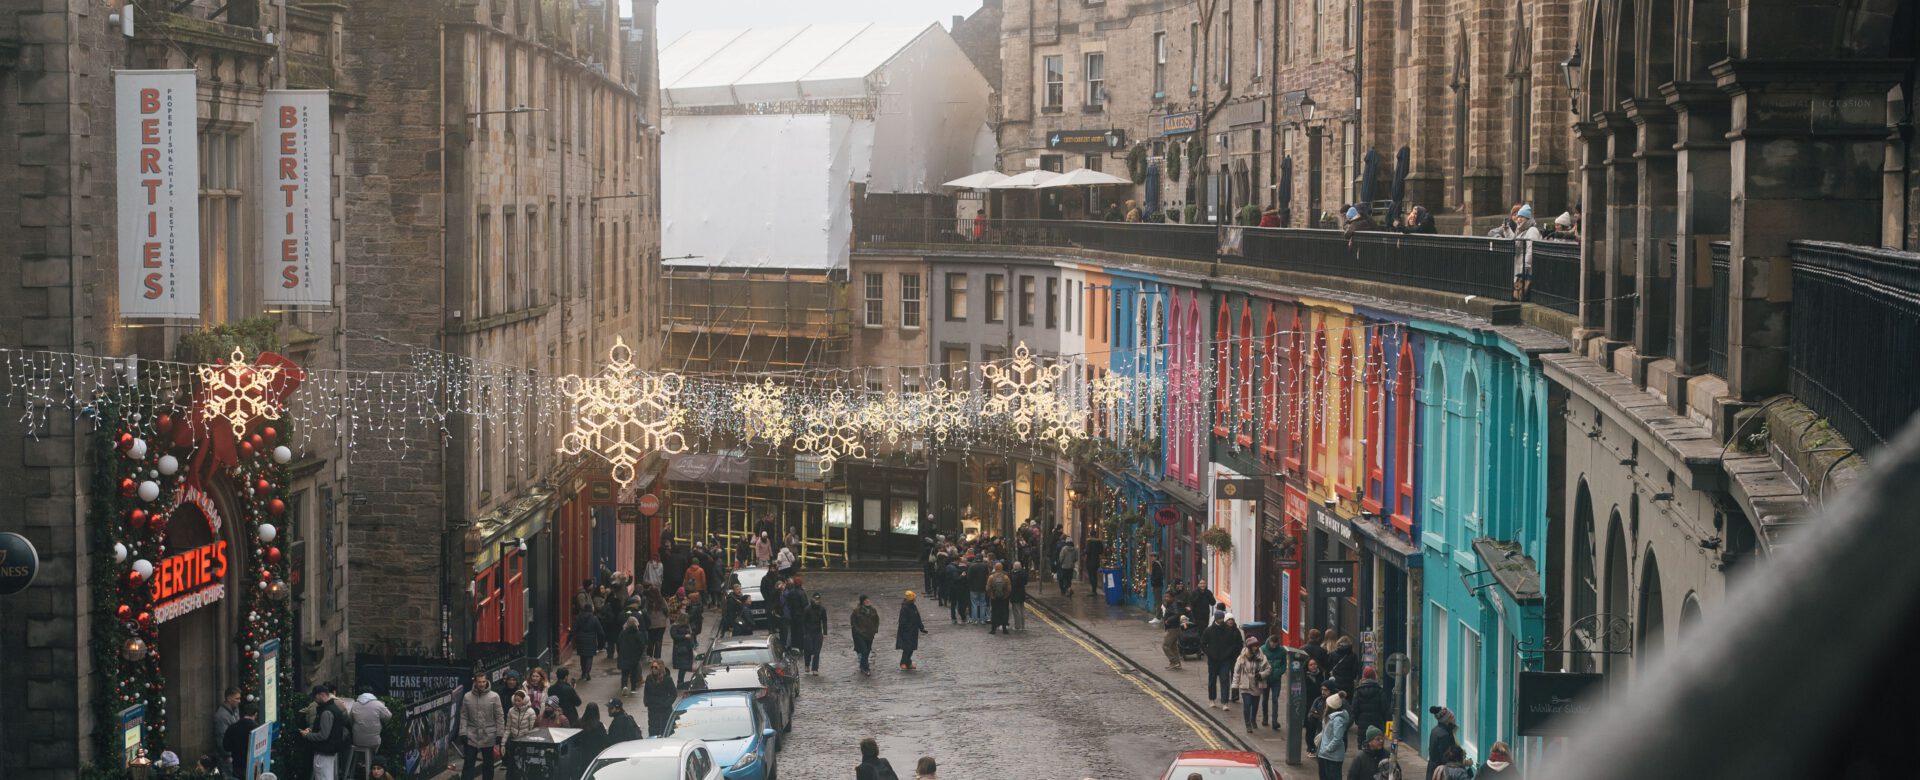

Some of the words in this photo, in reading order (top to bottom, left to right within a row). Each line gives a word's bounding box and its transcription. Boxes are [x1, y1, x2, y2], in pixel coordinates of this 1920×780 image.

[140, 88, 164, 300] BERTIES
[279, 105, 300, 289] BERTIES
[1317, 510, 1325, 525] THE
[1325, 514, 1340, 534] WHISKY
[1340, 523, 1352, 540] SHOP
[154, 601, 179, 624] ROPER
[179, 594, 196, 614] FISH
[203, 584, 225, 605] CHIPS
[390, 675, 420, 688] PLEASE
[422, 676, 460, 688] RECT
